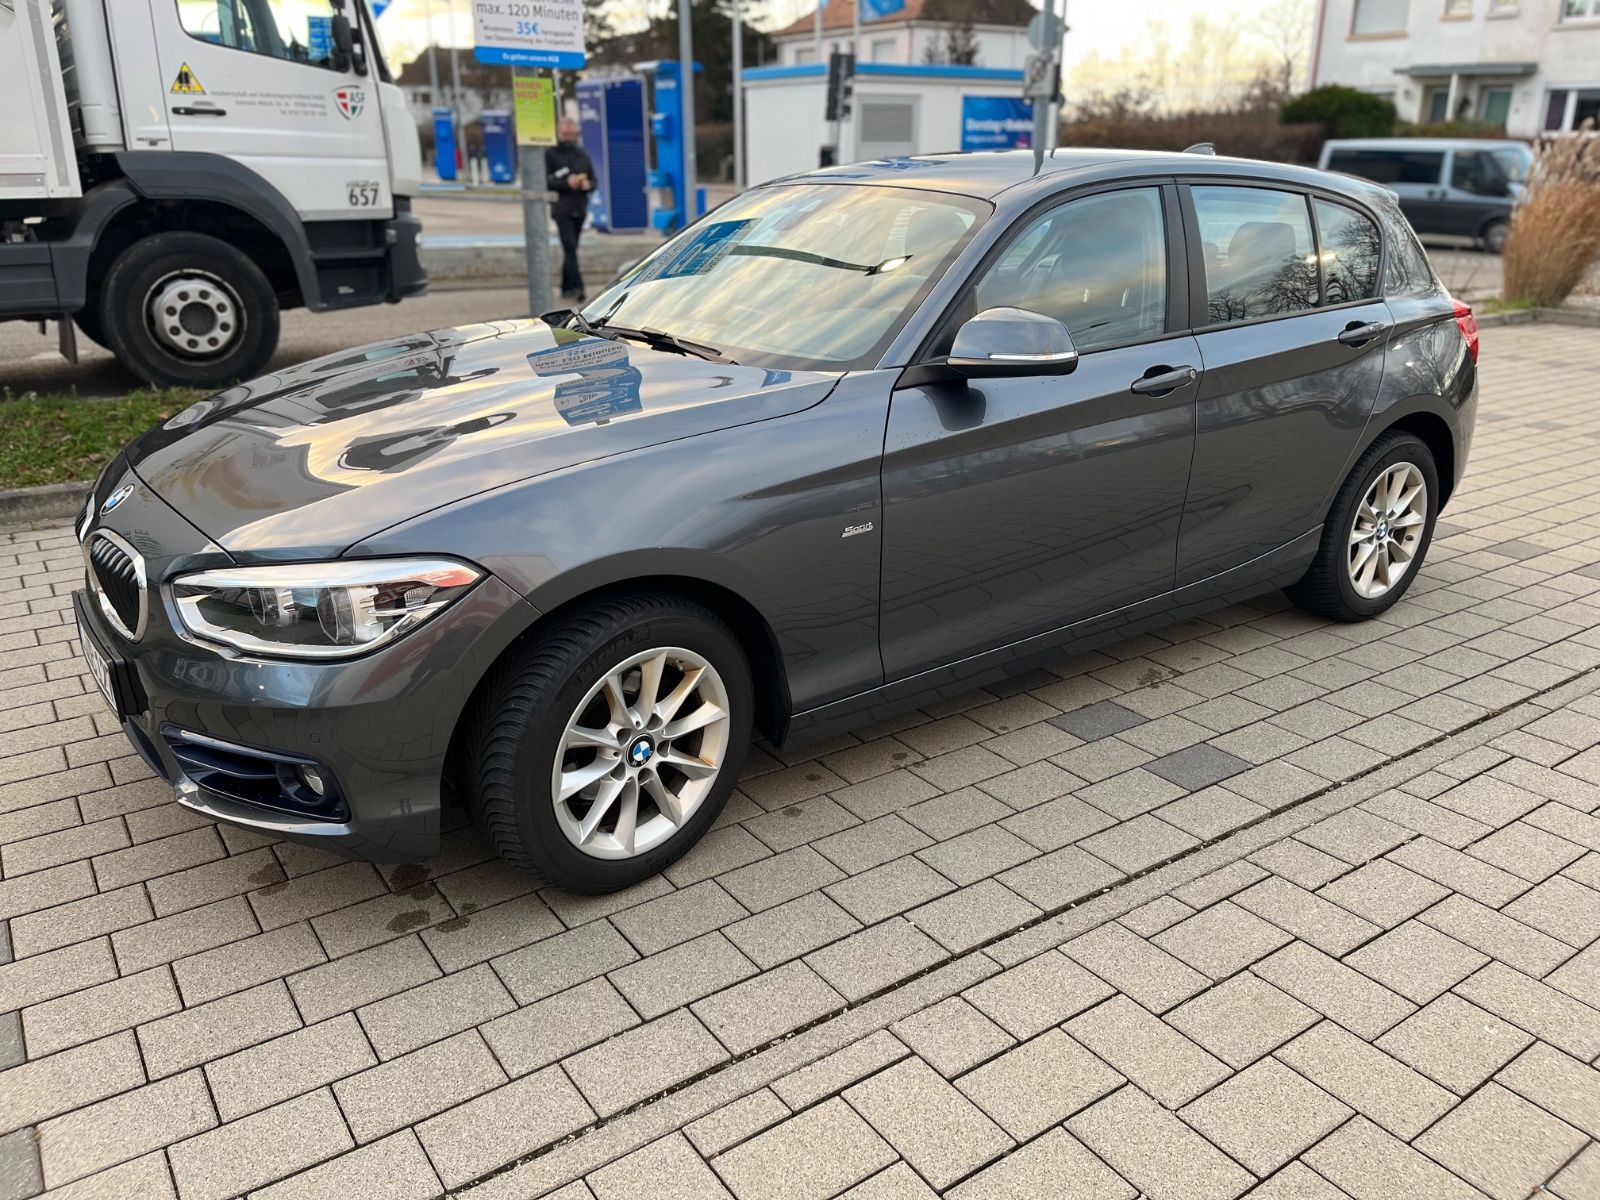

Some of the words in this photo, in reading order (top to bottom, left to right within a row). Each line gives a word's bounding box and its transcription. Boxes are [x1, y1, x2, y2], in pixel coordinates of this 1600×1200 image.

[476, 3, 505, 15] max.
[508, 4, 530, 17] 120
[532, 4, 579, 21] Minuten
[516, 21, 539, 34] 35€
[349, 92, 366, 103] ASF
[348, 188, 378, 207] 657
